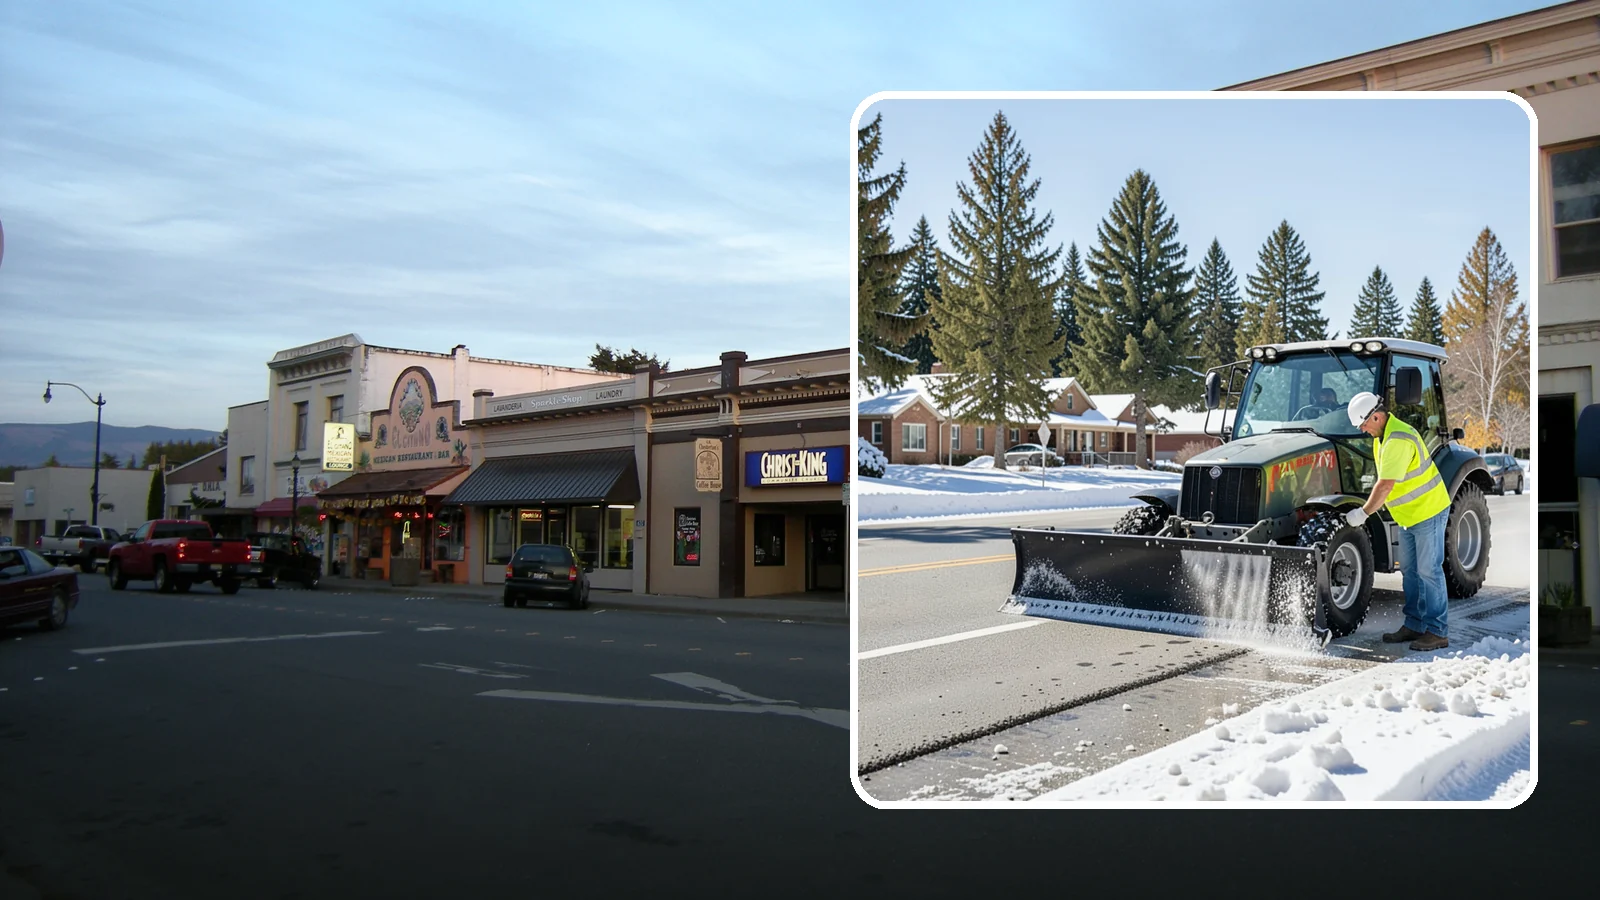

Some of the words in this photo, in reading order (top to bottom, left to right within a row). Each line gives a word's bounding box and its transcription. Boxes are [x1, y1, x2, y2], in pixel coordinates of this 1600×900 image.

[530, 396, 561, 409] Sparkle
[562, 394, 582, 404] Shop
[595, 389, 624, 400] LAUNDRY
[493, 402, 523, 413] LAVANDERIA
[373, 455, 396, 464] MEXICAN
[397, 451, 433, 462] RESTAURANT
[437, 450, 450, 459] BAR
[760, 451, 797, 478] CHRIST
[799, 450, 827, 476] KING
